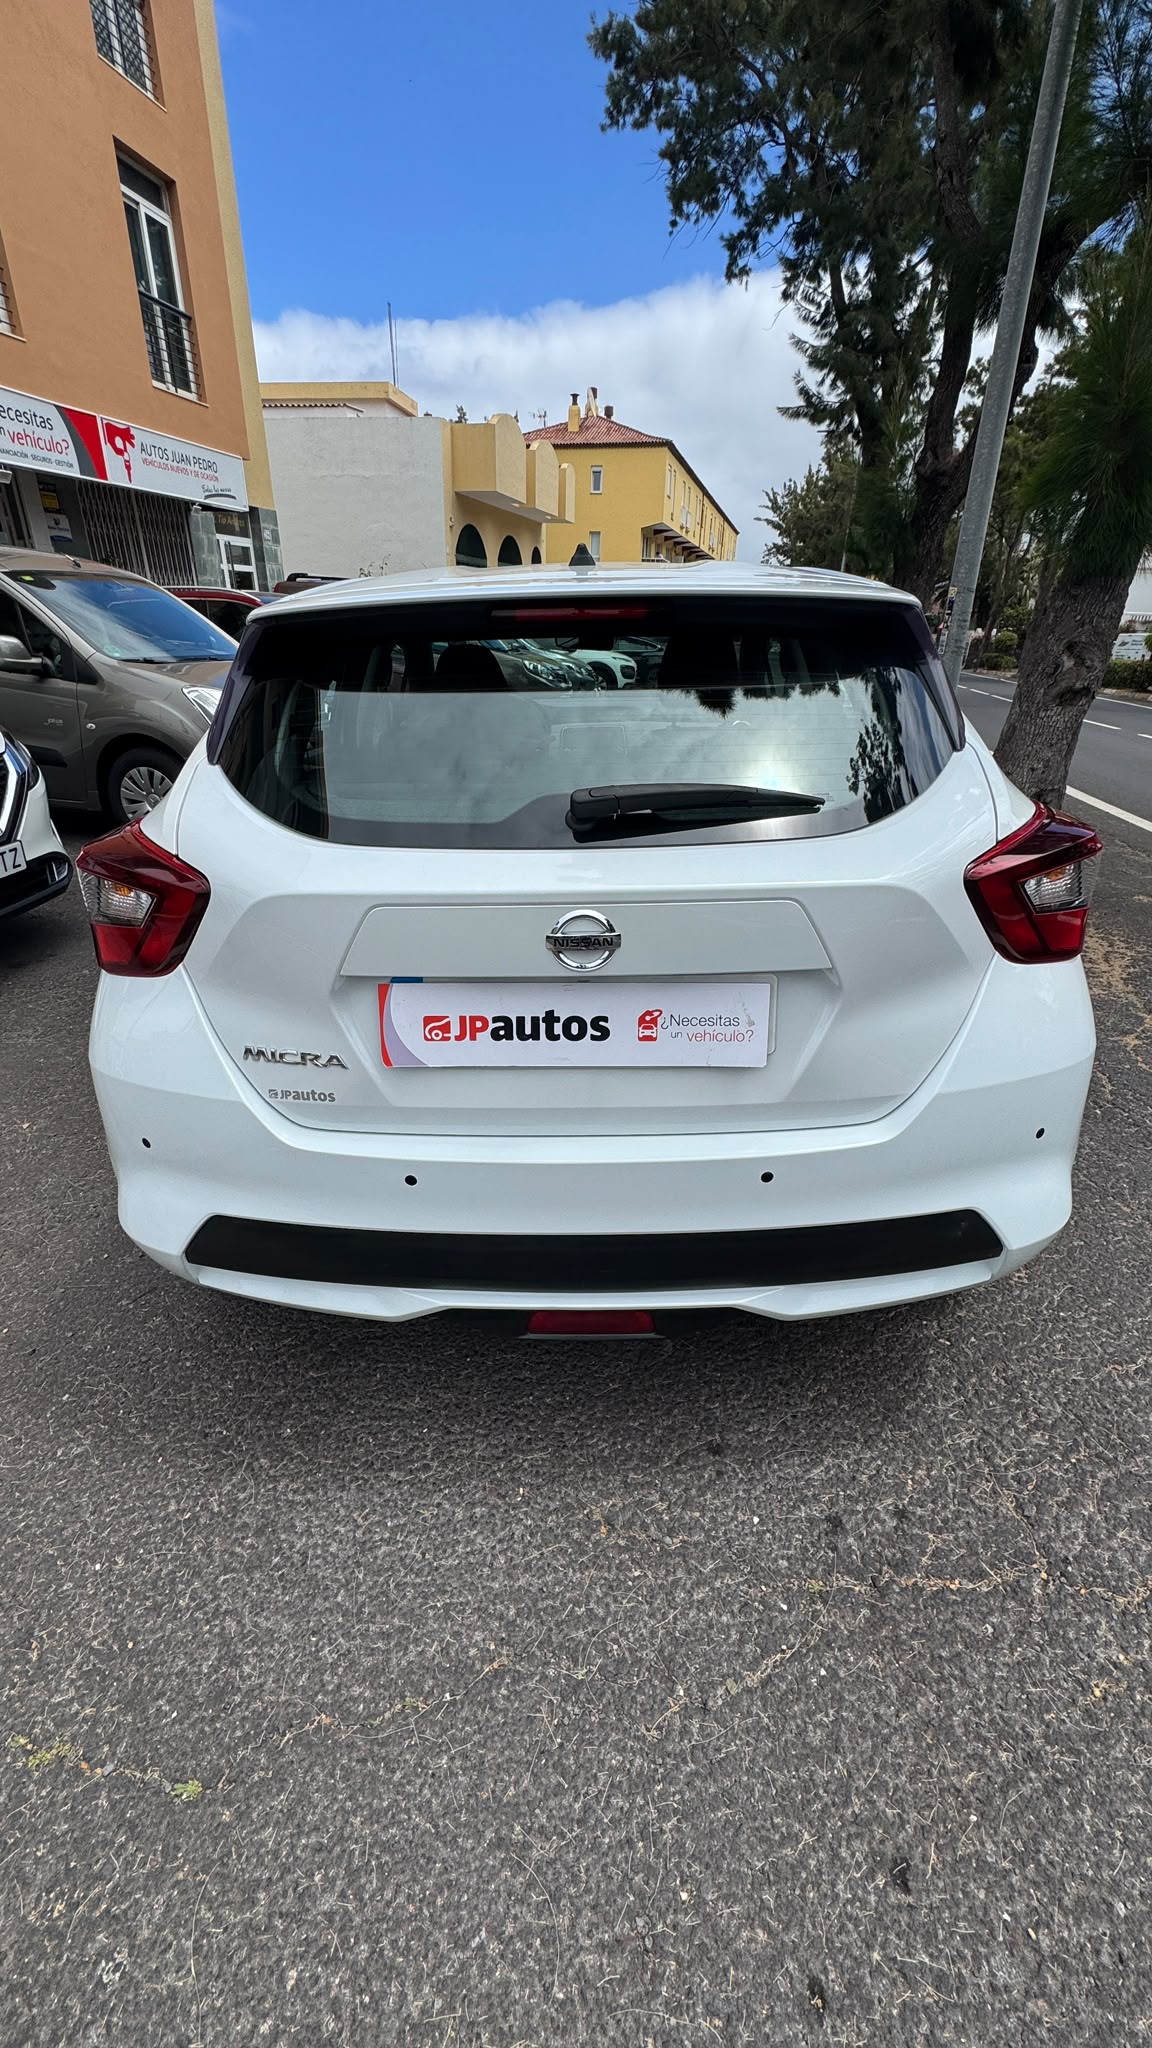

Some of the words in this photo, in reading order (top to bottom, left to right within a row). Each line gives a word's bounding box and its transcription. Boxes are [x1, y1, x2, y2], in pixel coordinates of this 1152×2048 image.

[7, 429, 70, 456] vehículo?
[140, 442, 169, 461] AUTOS
[171, 450, 192, 468] JUAN
[192, 456, 218, 474] PEDRO
[553, 937, 614, 948] NISSAN
[454, 1009, 611, 1042] JPautos
[660, 1013, 740, 1030] ¿Necesitas
[670, 1031, 682, 1039] un
[686, 1029, 754, 1043] vehículo?
[243, 1045, 349, 1070] MICRA
[279, 1088, 336, 1103] JPautos
